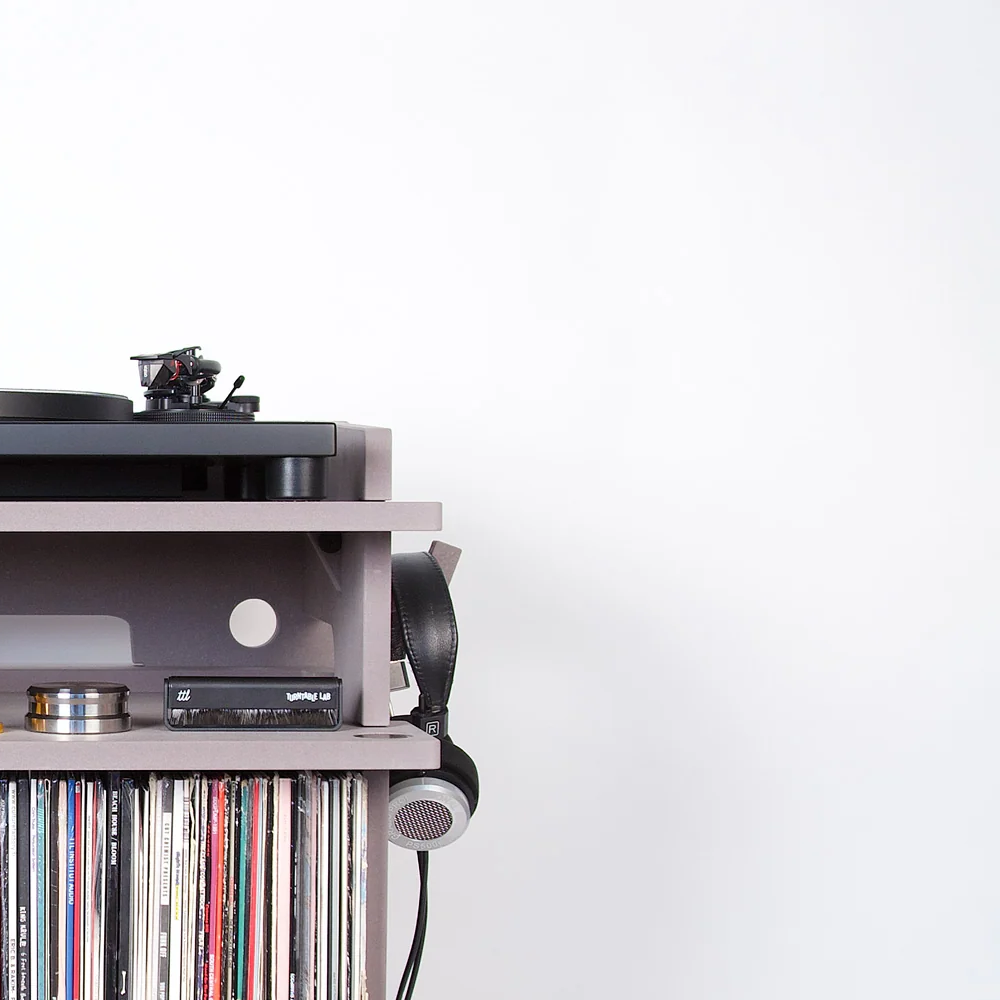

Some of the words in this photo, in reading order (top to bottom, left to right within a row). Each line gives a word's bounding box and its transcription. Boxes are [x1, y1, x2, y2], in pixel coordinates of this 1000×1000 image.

[176, 689, 192, 702] ttl
[286, 692, 318, 702] TURNTABLE
[319, 692, 332, 701] LAB
[429, 725, 437, 734] R
